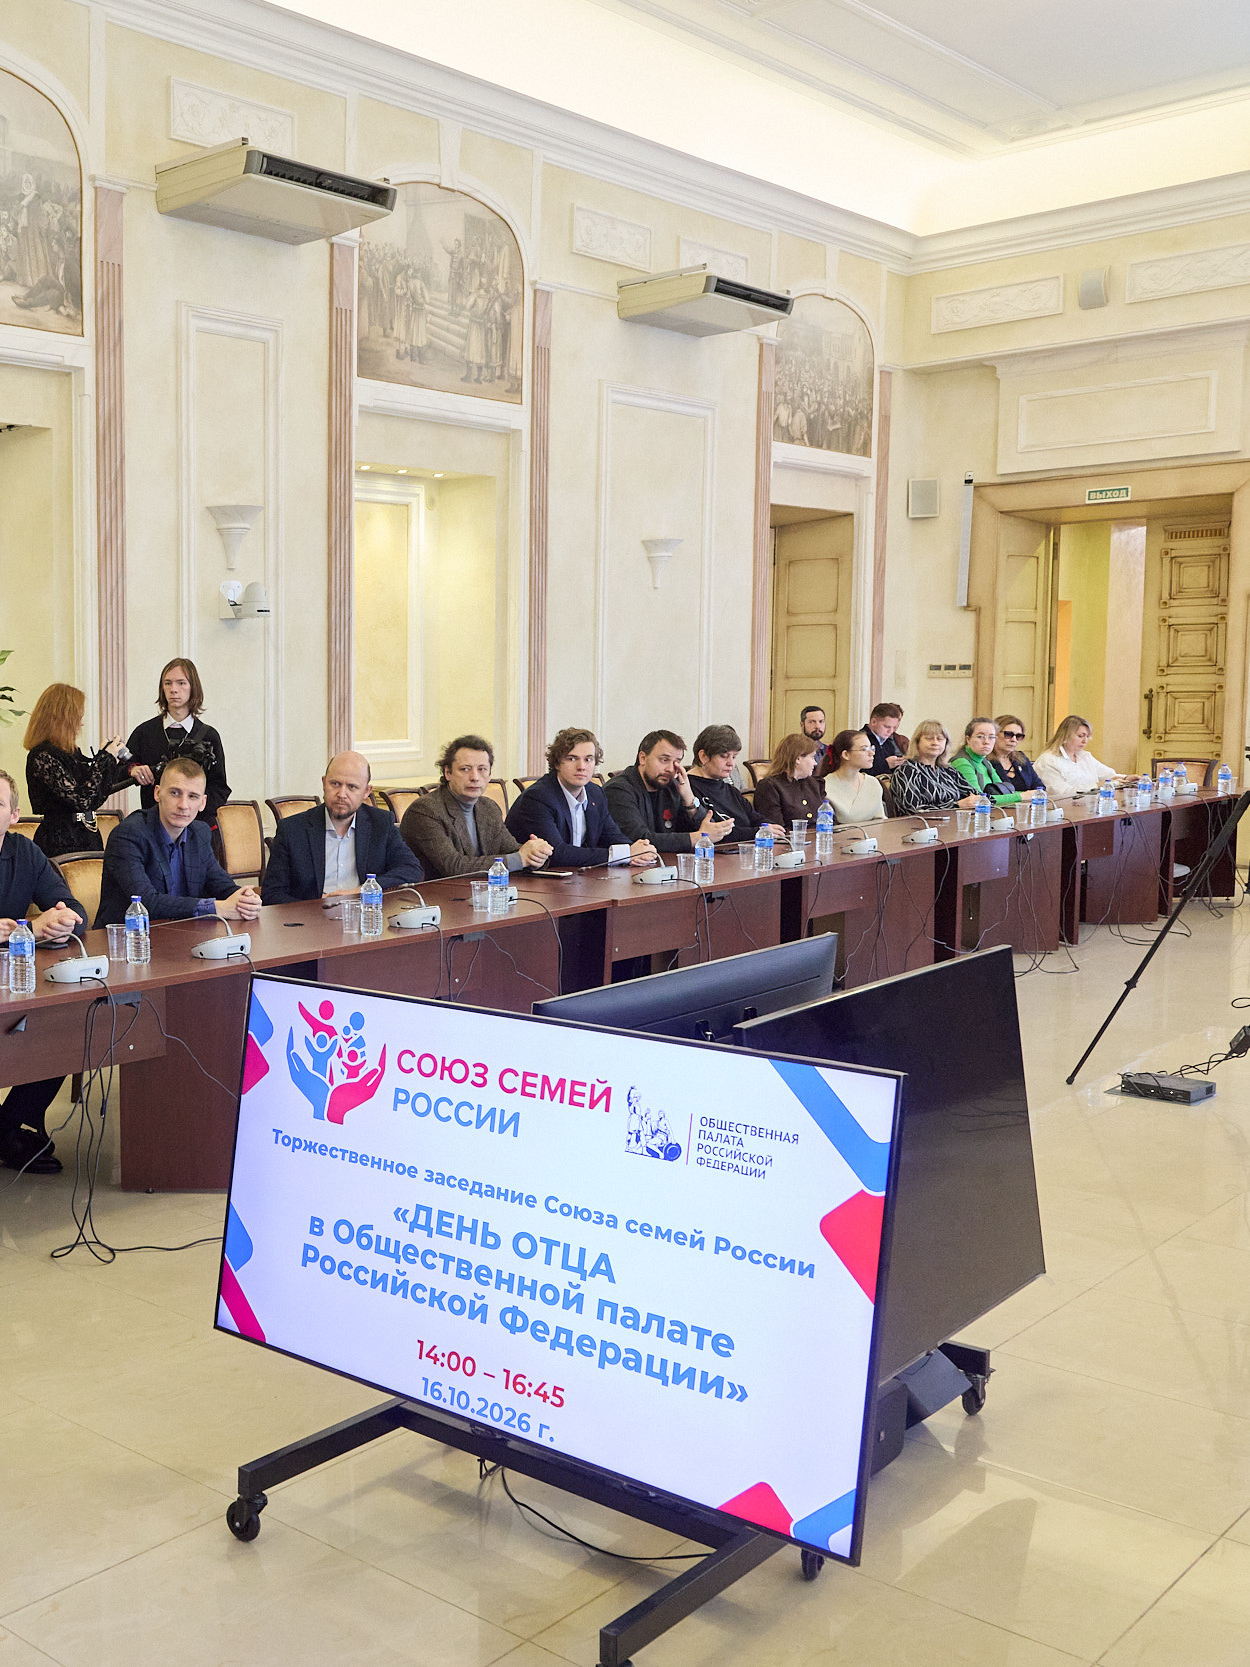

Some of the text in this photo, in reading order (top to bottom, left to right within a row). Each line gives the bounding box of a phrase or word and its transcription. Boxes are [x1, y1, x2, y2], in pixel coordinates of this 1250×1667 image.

[1090, 489, 1127, 500] ВЫХОД
[397, 1049, 612, 1112] СОЮЗ СЕМЕЙ
[393, 1088, 520, 1137] РОССИИ
[698, 1129, 745, 1148] ПАЛАТА
[700, 1116, 799, 1145] ОБЩЕСТВЕННАЯ
[696, 1156, 766, 1180] ФЕДЕРАЦИИ
[697, 1142, 773, 1168] РОССИЙСКОЙ
[272, 1128, 815, 1279] Торжественное заседание Союза семей России
[394, 1204, 616, 1284] «ДЕНЬ ОТЦА
[309, 1216, 734, 1357] в Общественной палате
[301, 1243, 748, 1402] Российской Федерации»
[417, 1339, 476, 1377] 14:00
[503, 1368, 564, 1408] 16:45
[422, 1377, 554, 1442] 16.10.2026 г.
